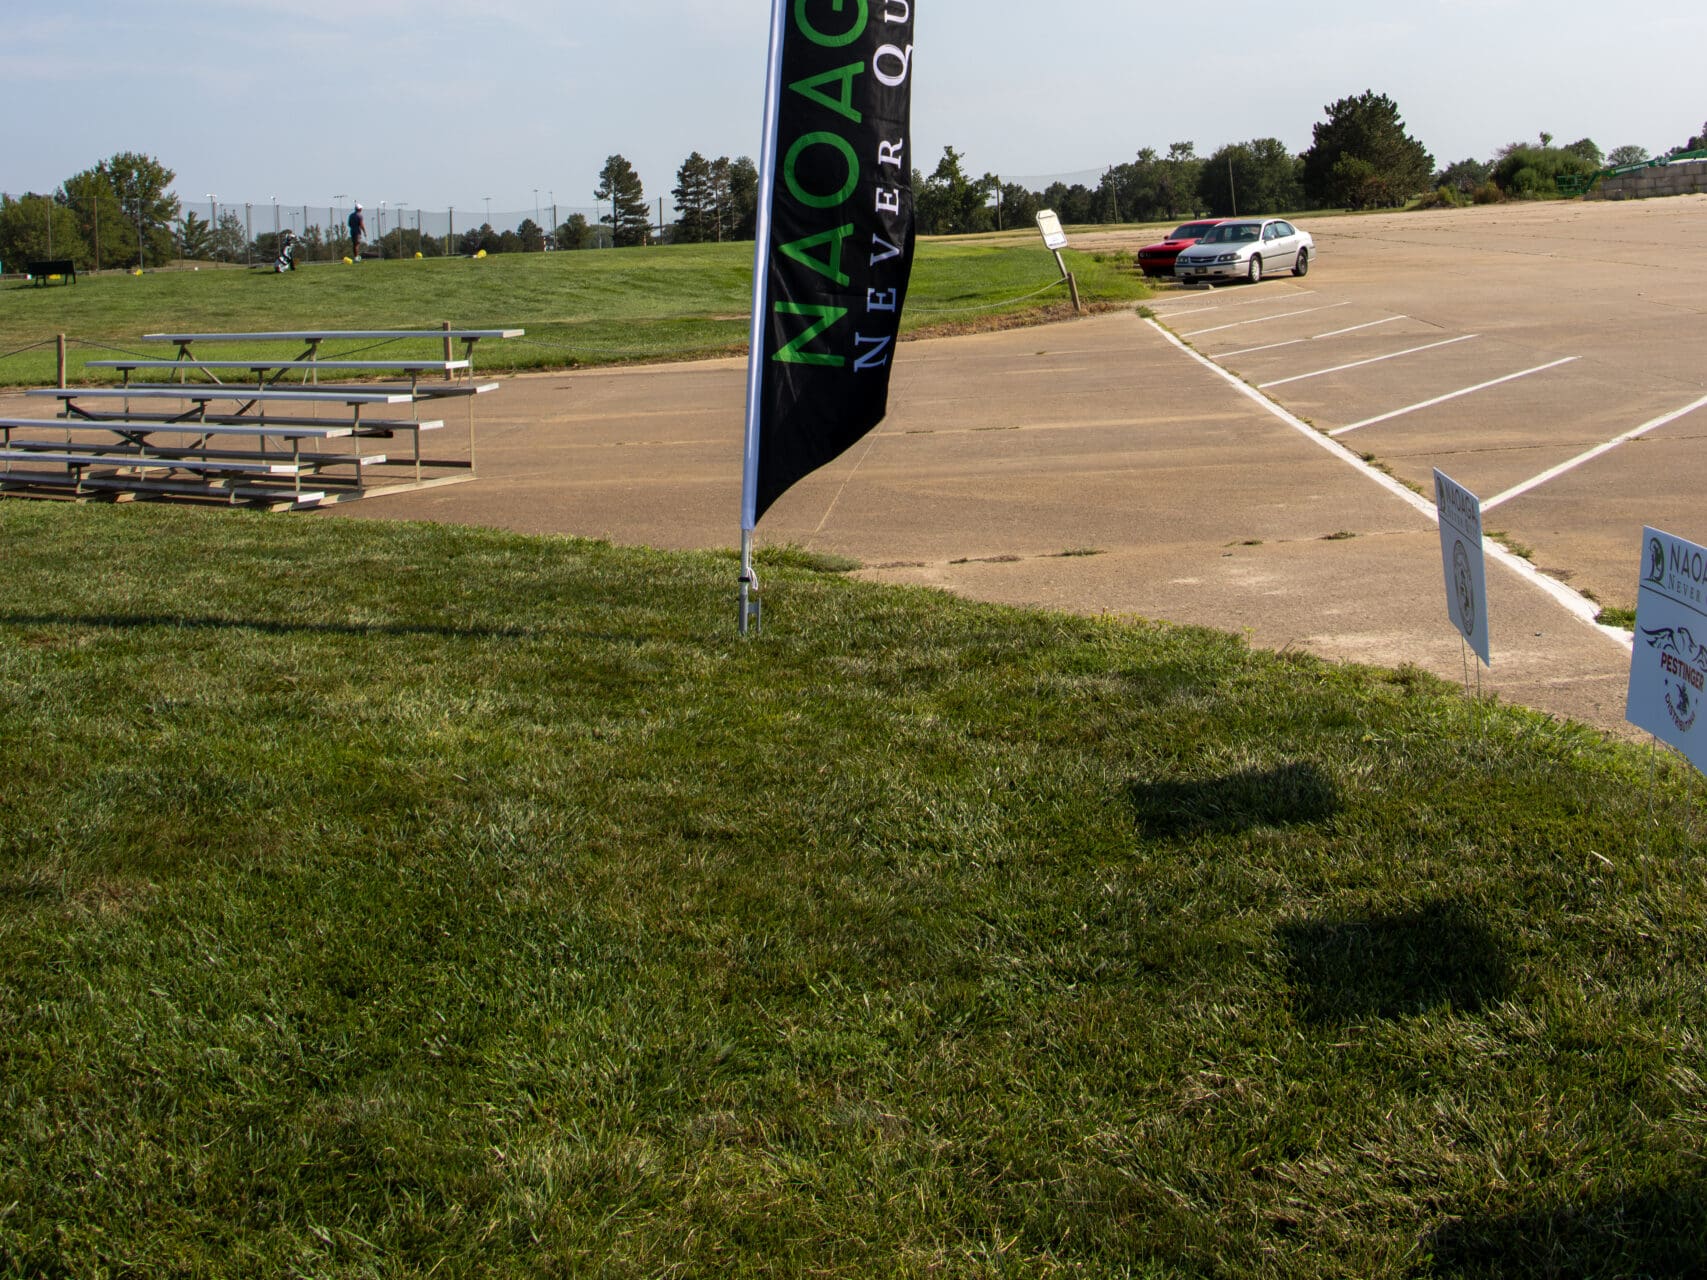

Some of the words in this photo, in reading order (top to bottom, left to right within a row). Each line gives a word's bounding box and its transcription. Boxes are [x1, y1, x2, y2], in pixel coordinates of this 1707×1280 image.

[853, 138, 902, 373] NEVER
[1667, 573, 1702, 604] NEVER
[1660, 651, 1705, 693] PESTINGER
